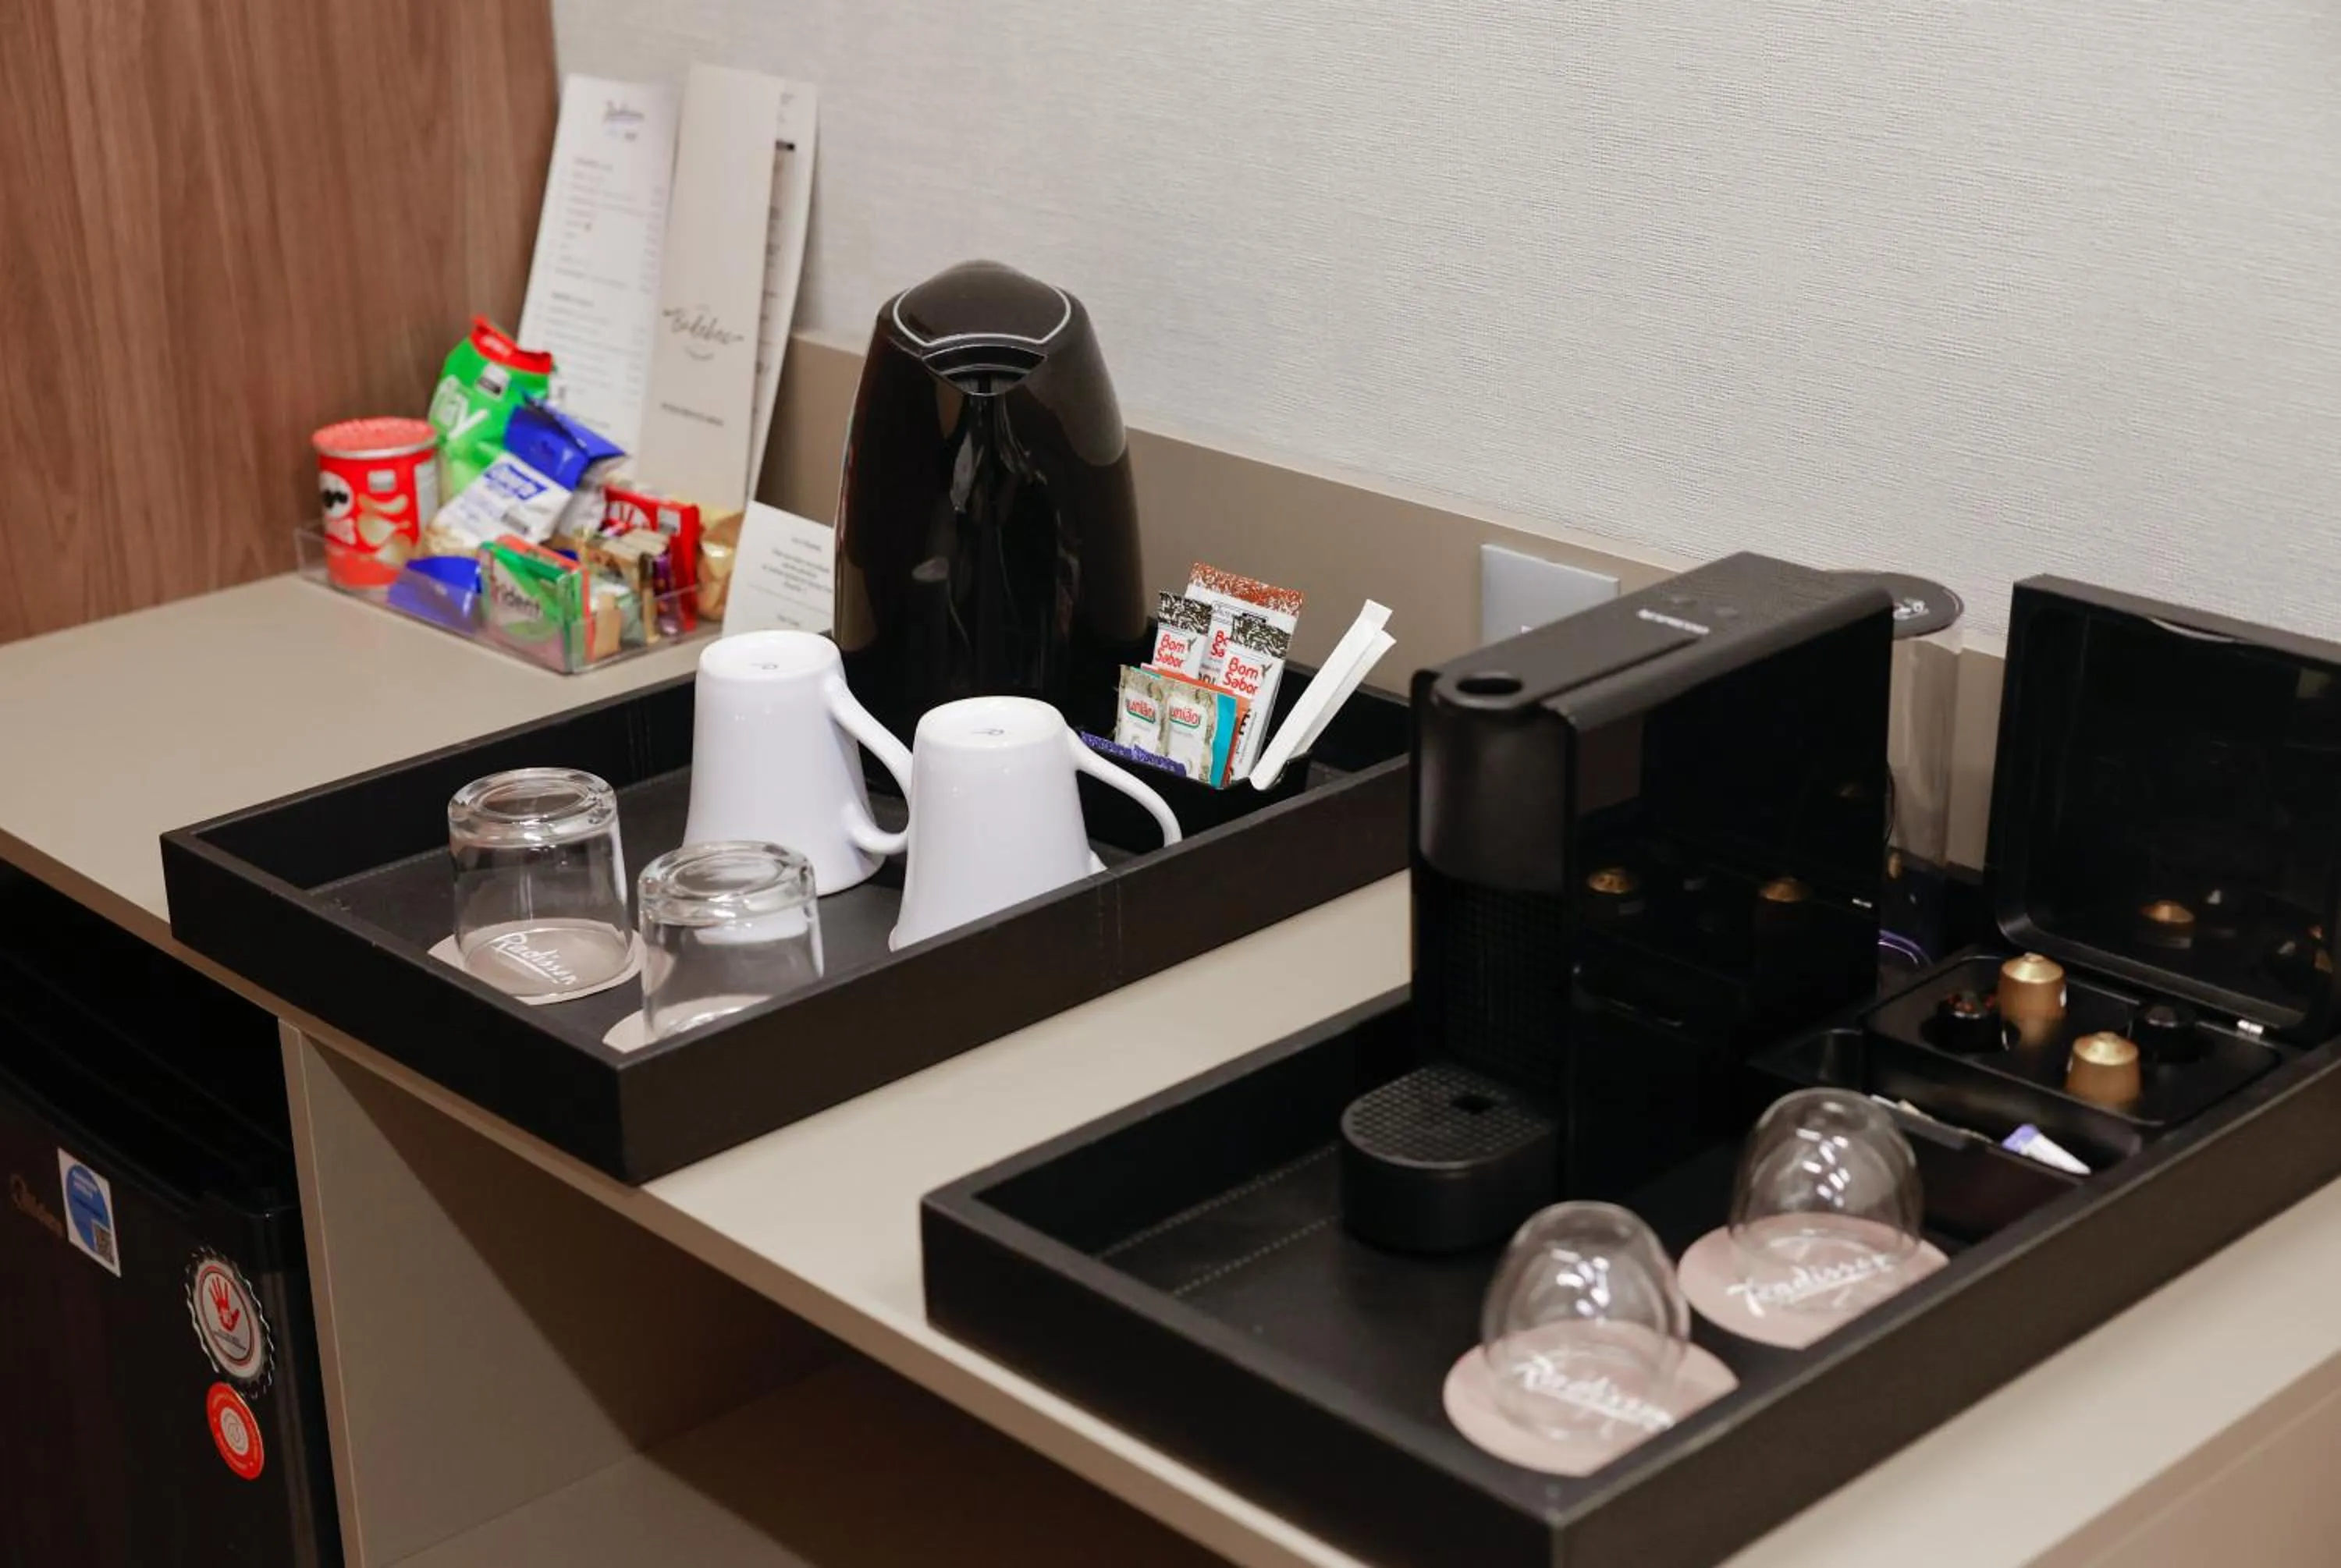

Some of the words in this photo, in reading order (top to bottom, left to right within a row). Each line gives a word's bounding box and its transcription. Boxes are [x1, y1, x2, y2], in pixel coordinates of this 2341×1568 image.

[1160, 633, 1185, 651] Bom
[1155, 647, 1184, 669] Sabor
[1228, 657, 1259, 680] Bom
[1223, 671, 1259, 695] Sabor
[494, 932, 577, 985] Radisson
